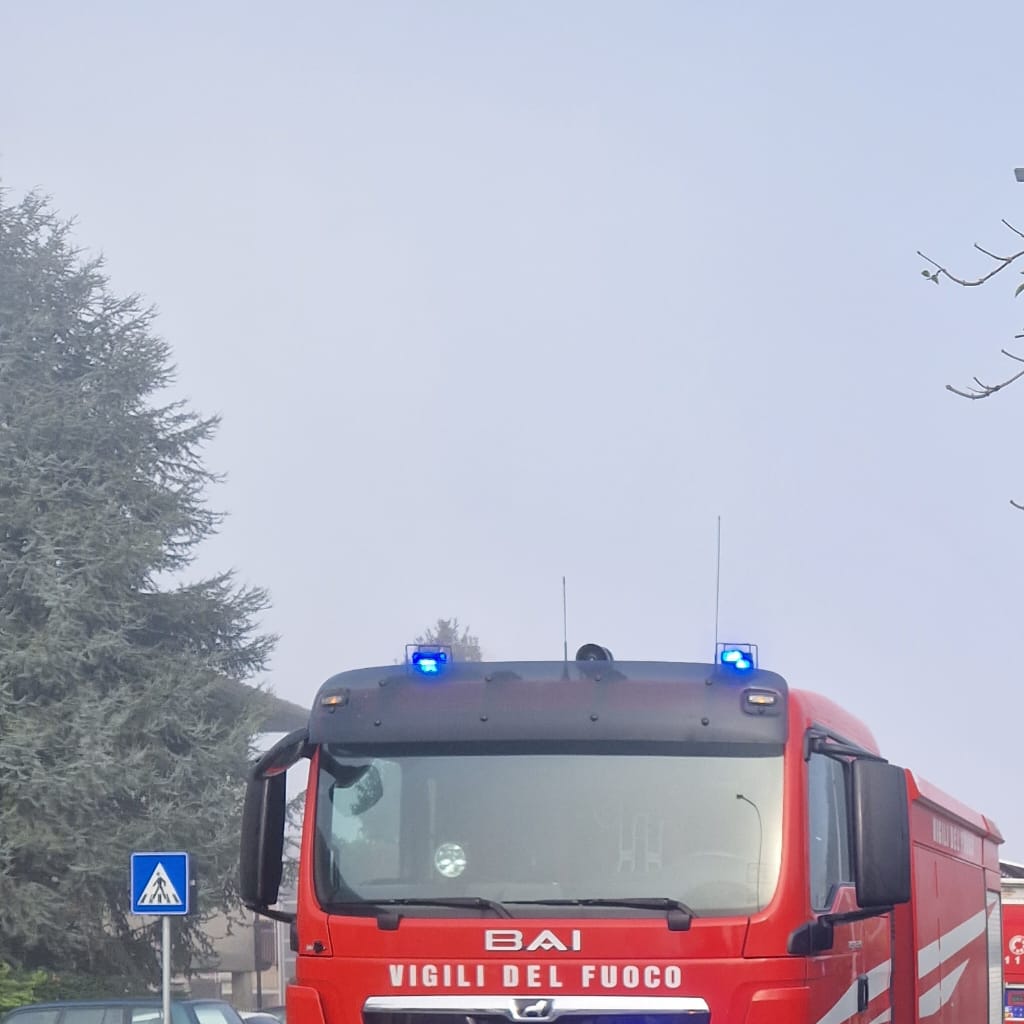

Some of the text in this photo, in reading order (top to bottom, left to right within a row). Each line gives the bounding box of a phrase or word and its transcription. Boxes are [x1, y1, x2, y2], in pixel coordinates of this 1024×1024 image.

[484, 929, 581, 951] BAI
[389, 964, 682, 989] VIGILI DEL FUOCO
